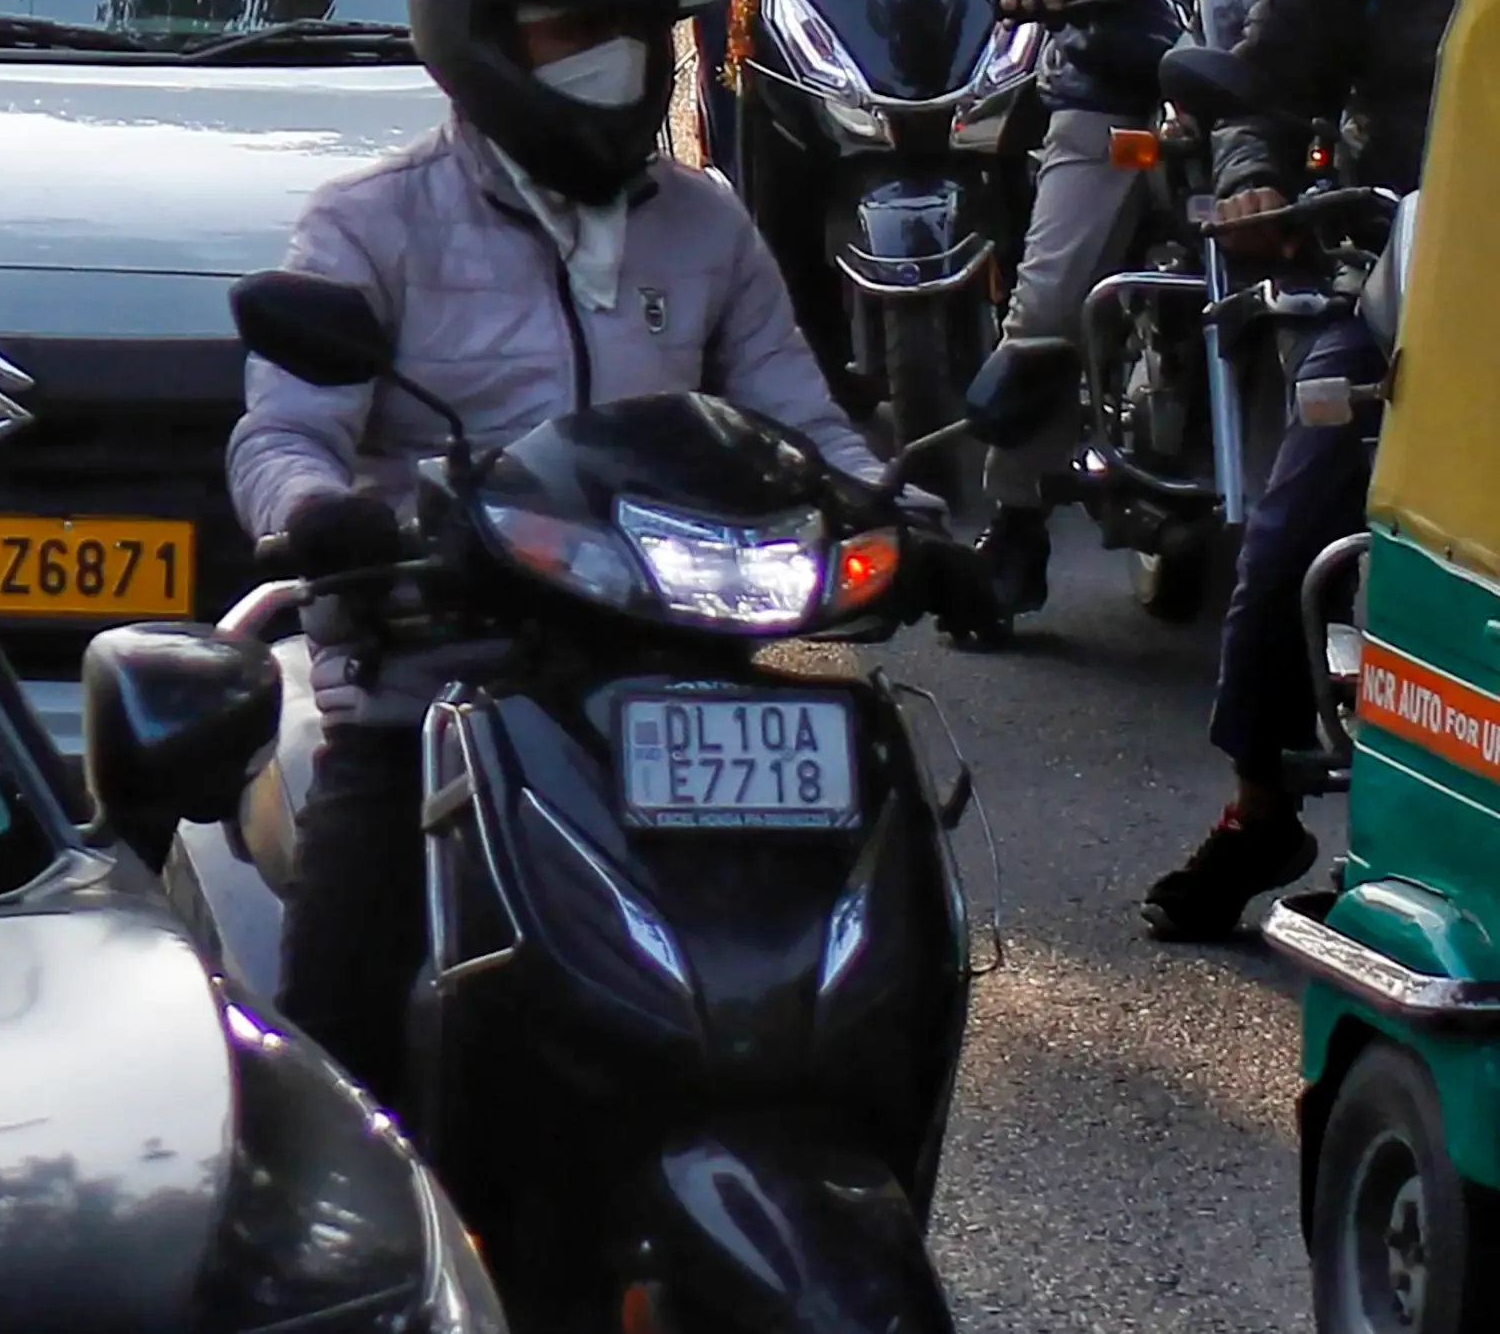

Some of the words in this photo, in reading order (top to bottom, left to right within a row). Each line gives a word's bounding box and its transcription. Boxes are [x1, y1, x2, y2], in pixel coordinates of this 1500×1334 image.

[1362, 662, 1396, 712] NCR
[1398, 679, 1442, 734] AUTO
[1444, 705, 1480, 750] FOR
[669, 757, 822, 804] E7718
